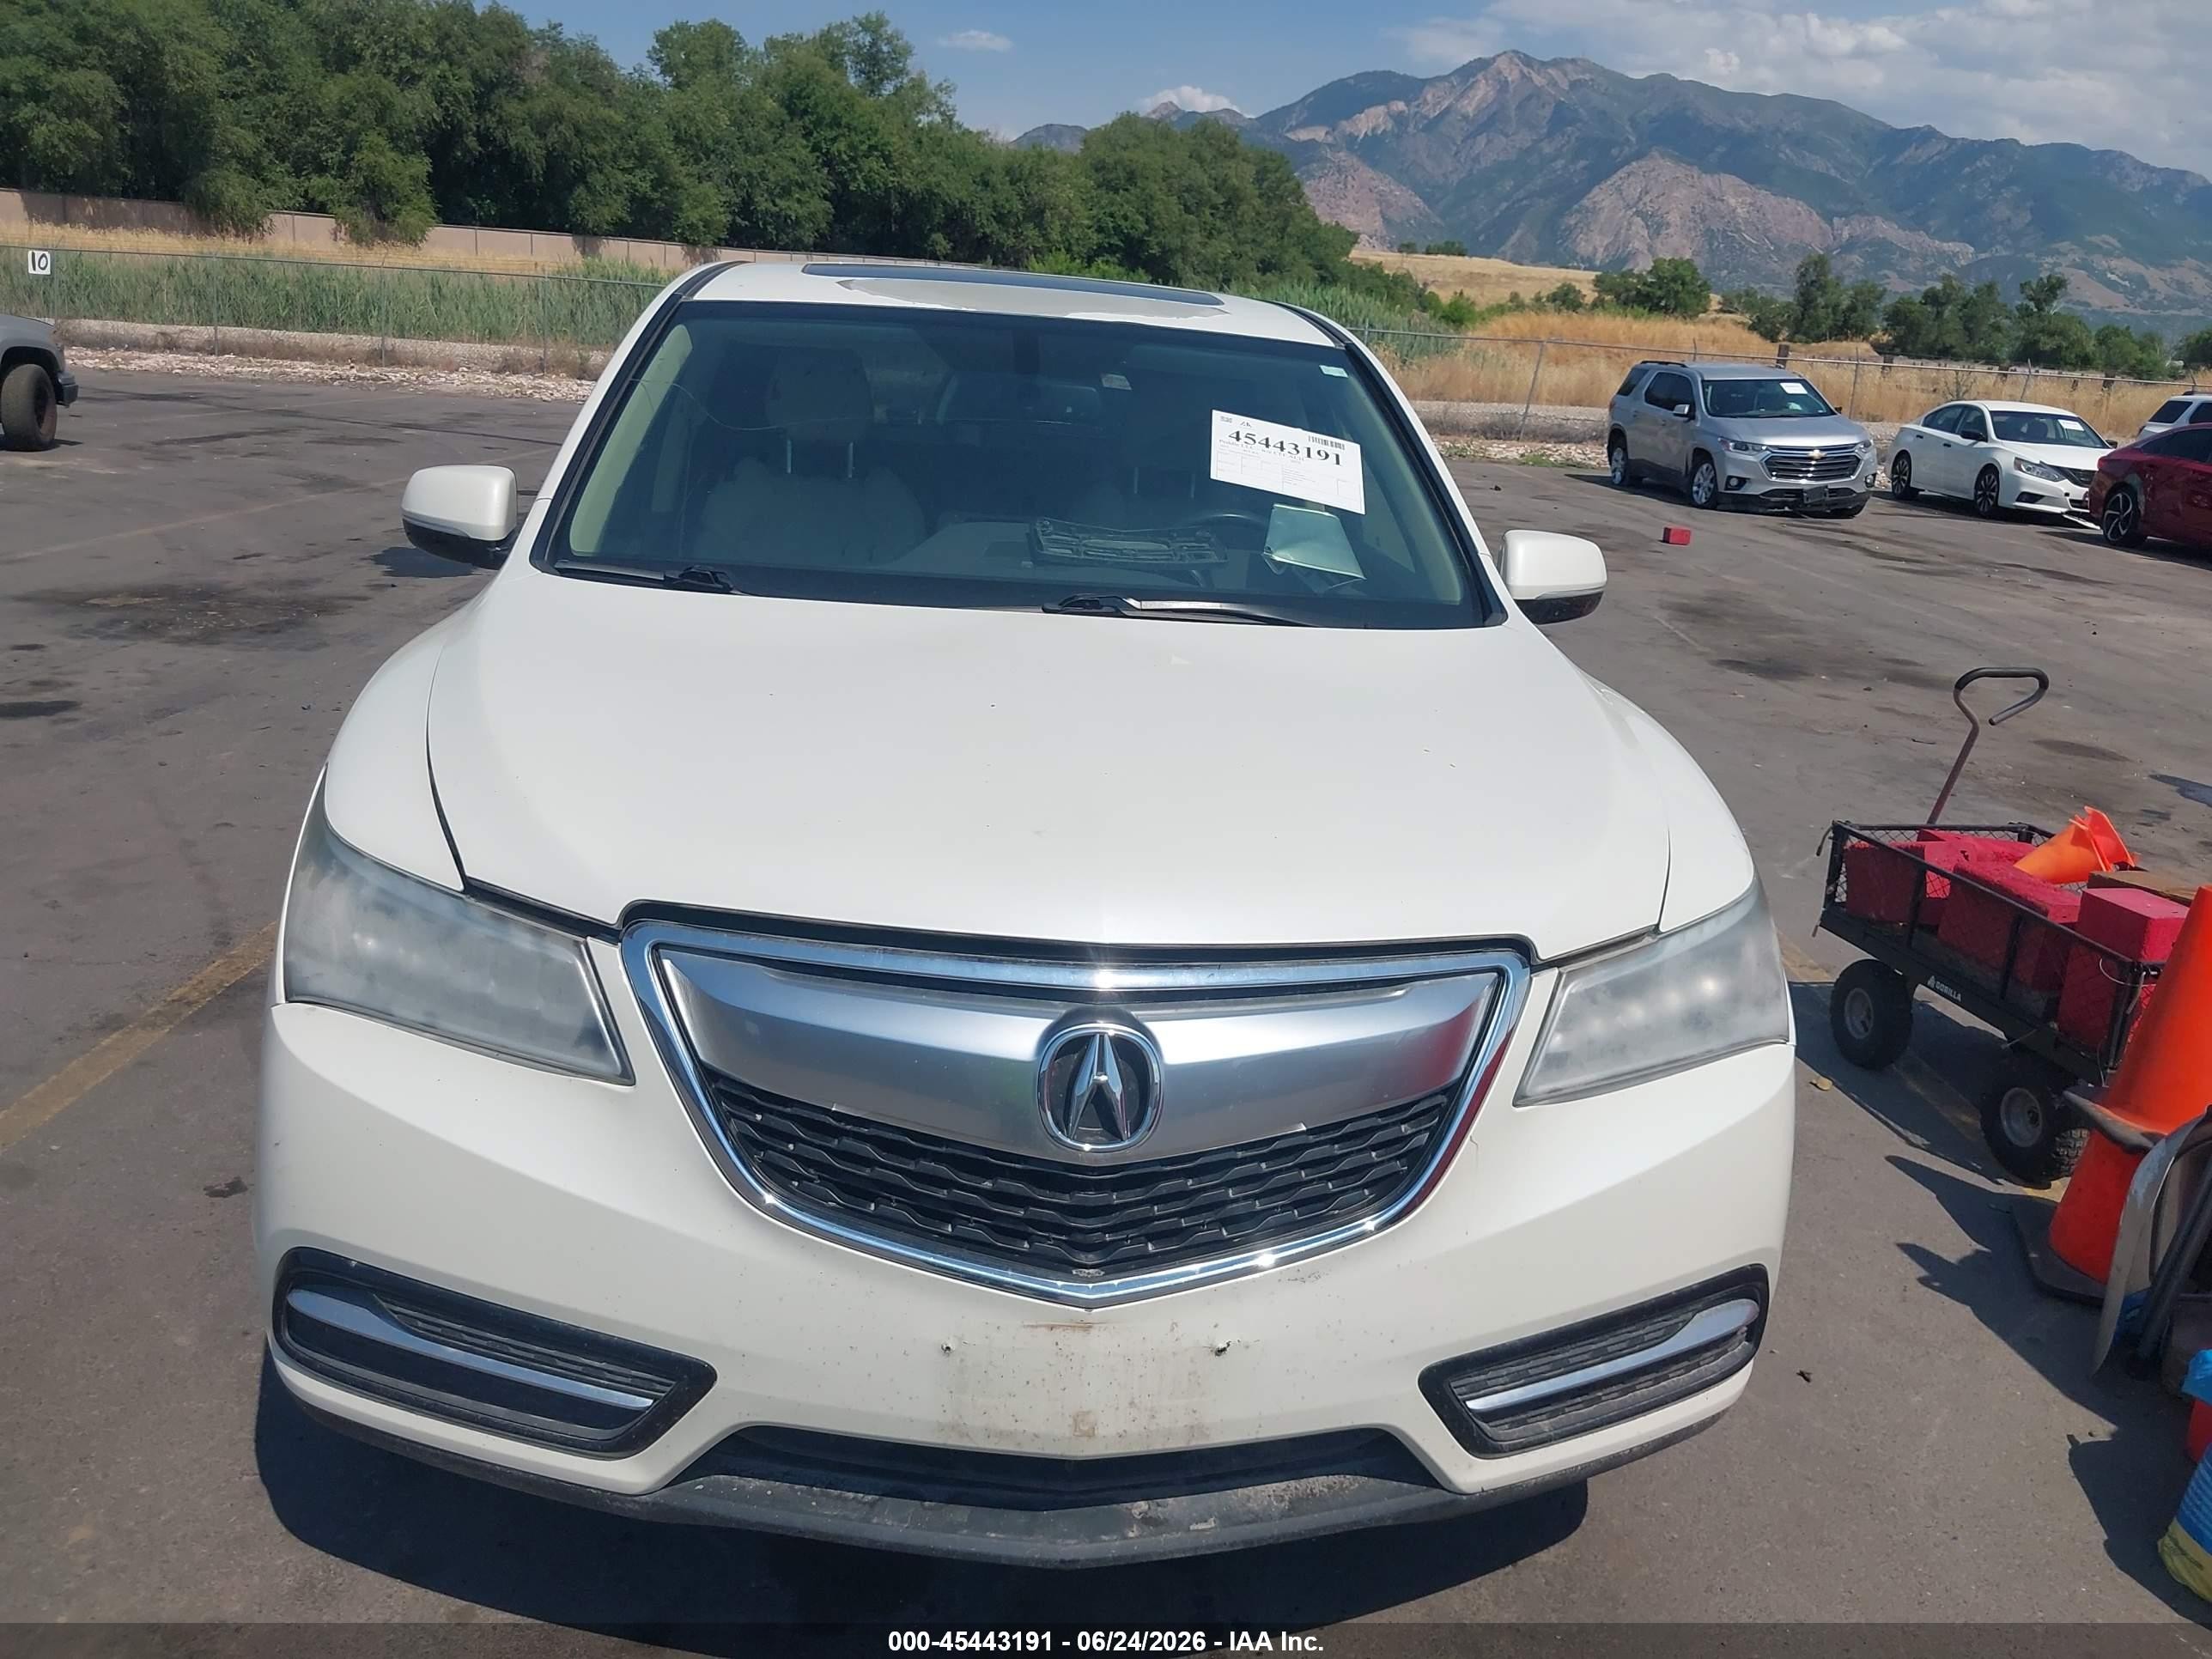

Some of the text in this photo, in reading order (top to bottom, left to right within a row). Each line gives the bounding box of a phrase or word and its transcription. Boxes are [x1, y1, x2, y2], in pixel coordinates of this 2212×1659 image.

[31, 251, 49, 271] 10
[1228, 429, 1343, 466] 45443191
[1936, 981, 1962, 1002] GORILLA
